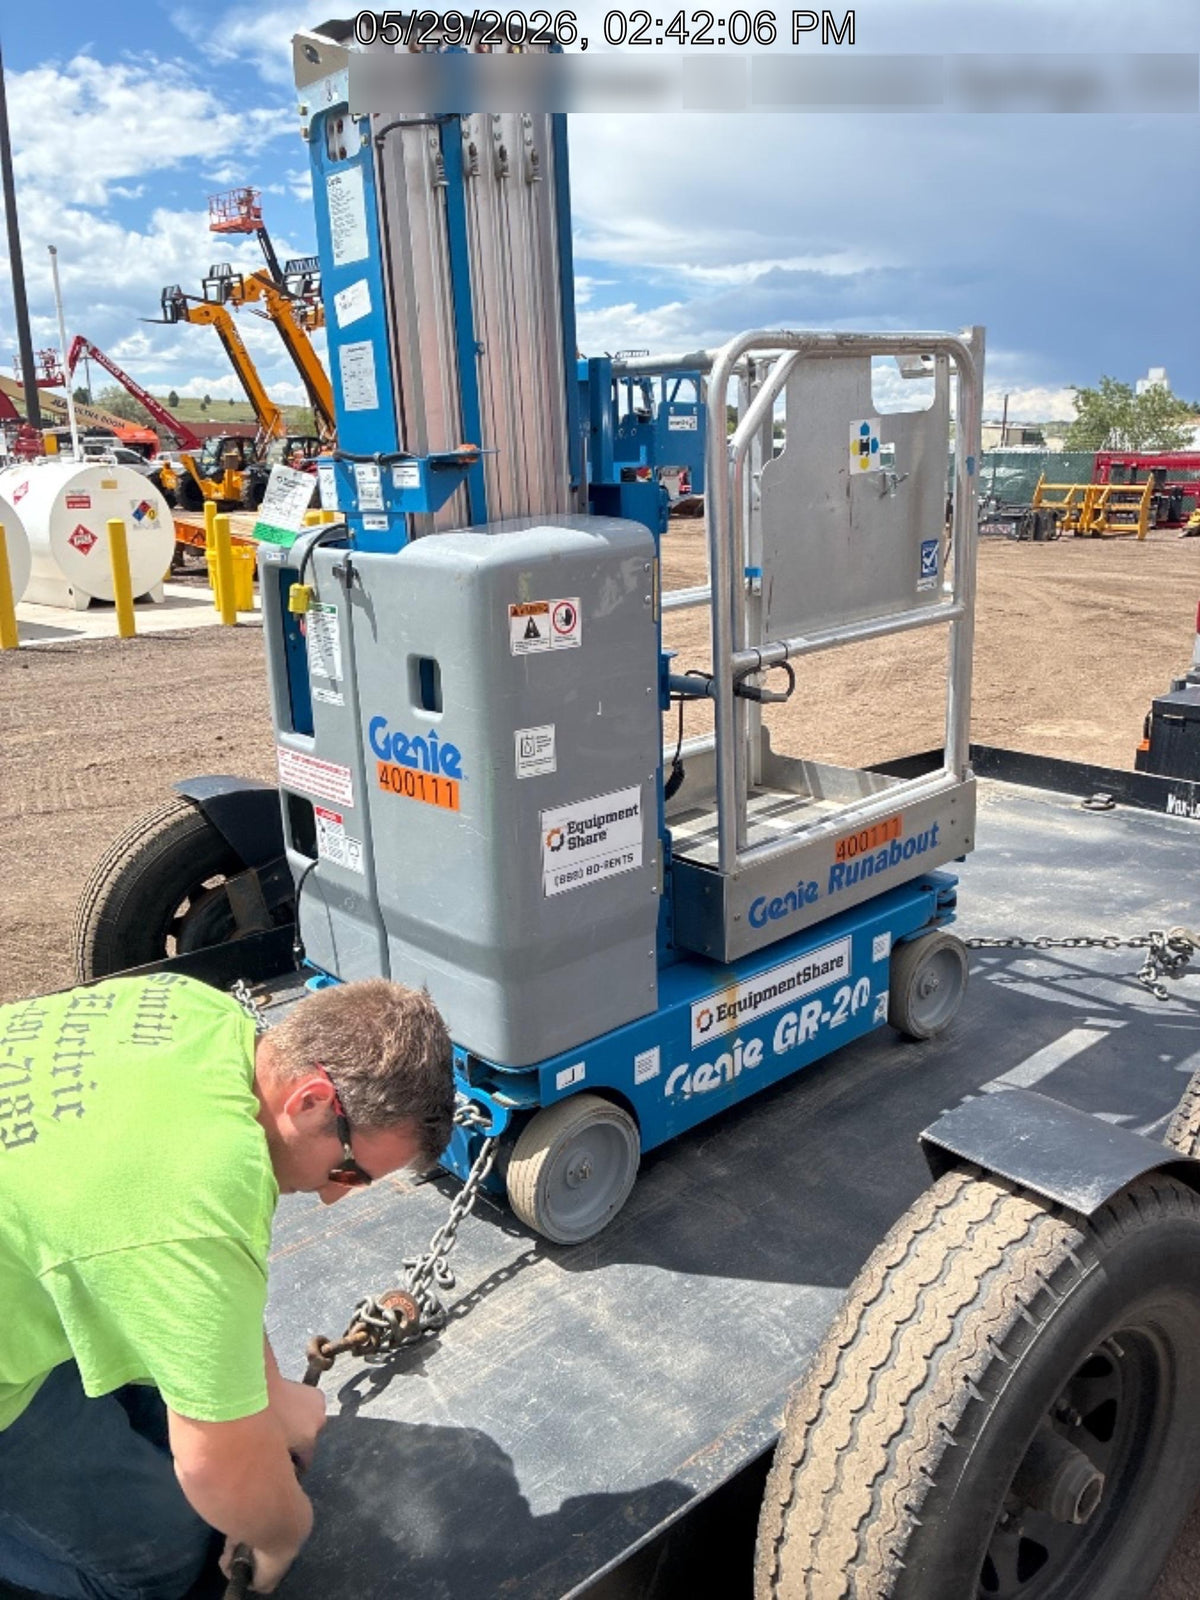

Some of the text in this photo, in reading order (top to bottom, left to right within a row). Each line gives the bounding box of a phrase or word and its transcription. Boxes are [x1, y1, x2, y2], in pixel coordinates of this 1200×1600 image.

[369, 715, 463, 780] Genie
[379, 764, 454, 808] 400111
[566, 803, 640, 836] Equipment
[567, 829, 608, 851] Share
[836, 816, 901, 861] 400111
[748, 820, 940, 929] Genie Runabout
[120, 972, 188, 1046] Smith
[715, 954, 844, 1023] EquipmentShare
[50, 993, 116, 1122] Electric
[663, 976, 871, 1101] Genie GR-20
